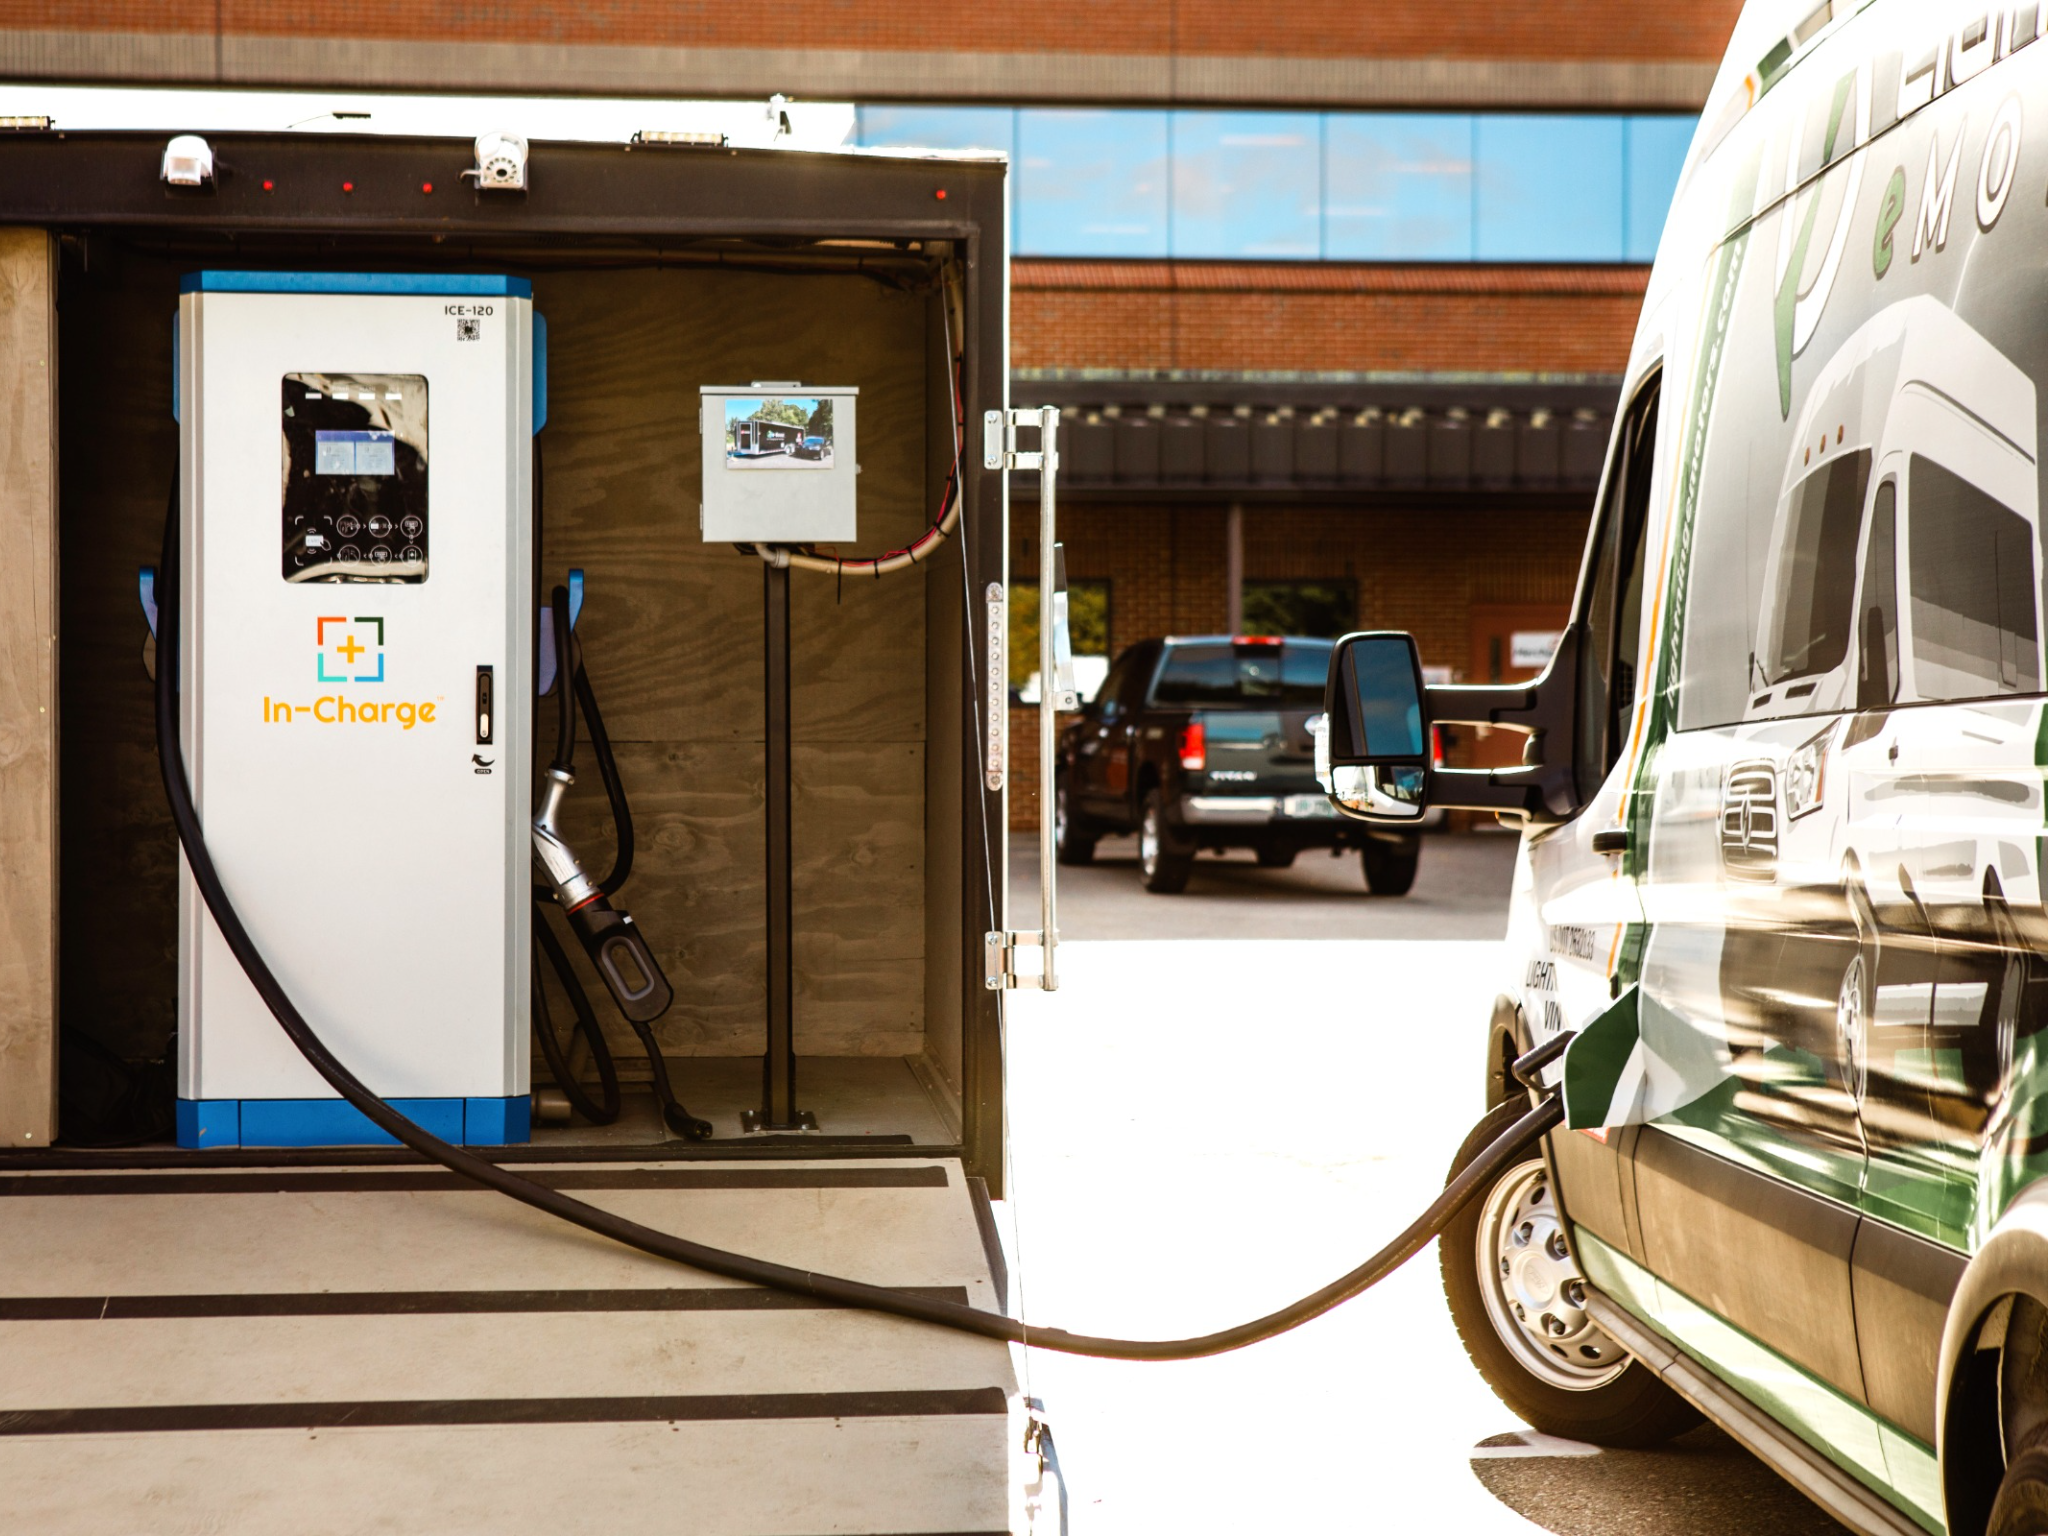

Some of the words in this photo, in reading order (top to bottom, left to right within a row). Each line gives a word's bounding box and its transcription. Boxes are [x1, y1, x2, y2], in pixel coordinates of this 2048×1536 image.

[444, 305, 494, 316] ICE-120
[1665, 240, 1743, 711] lightningemotors.com
[263, 695, 436, 730] In-Charge
